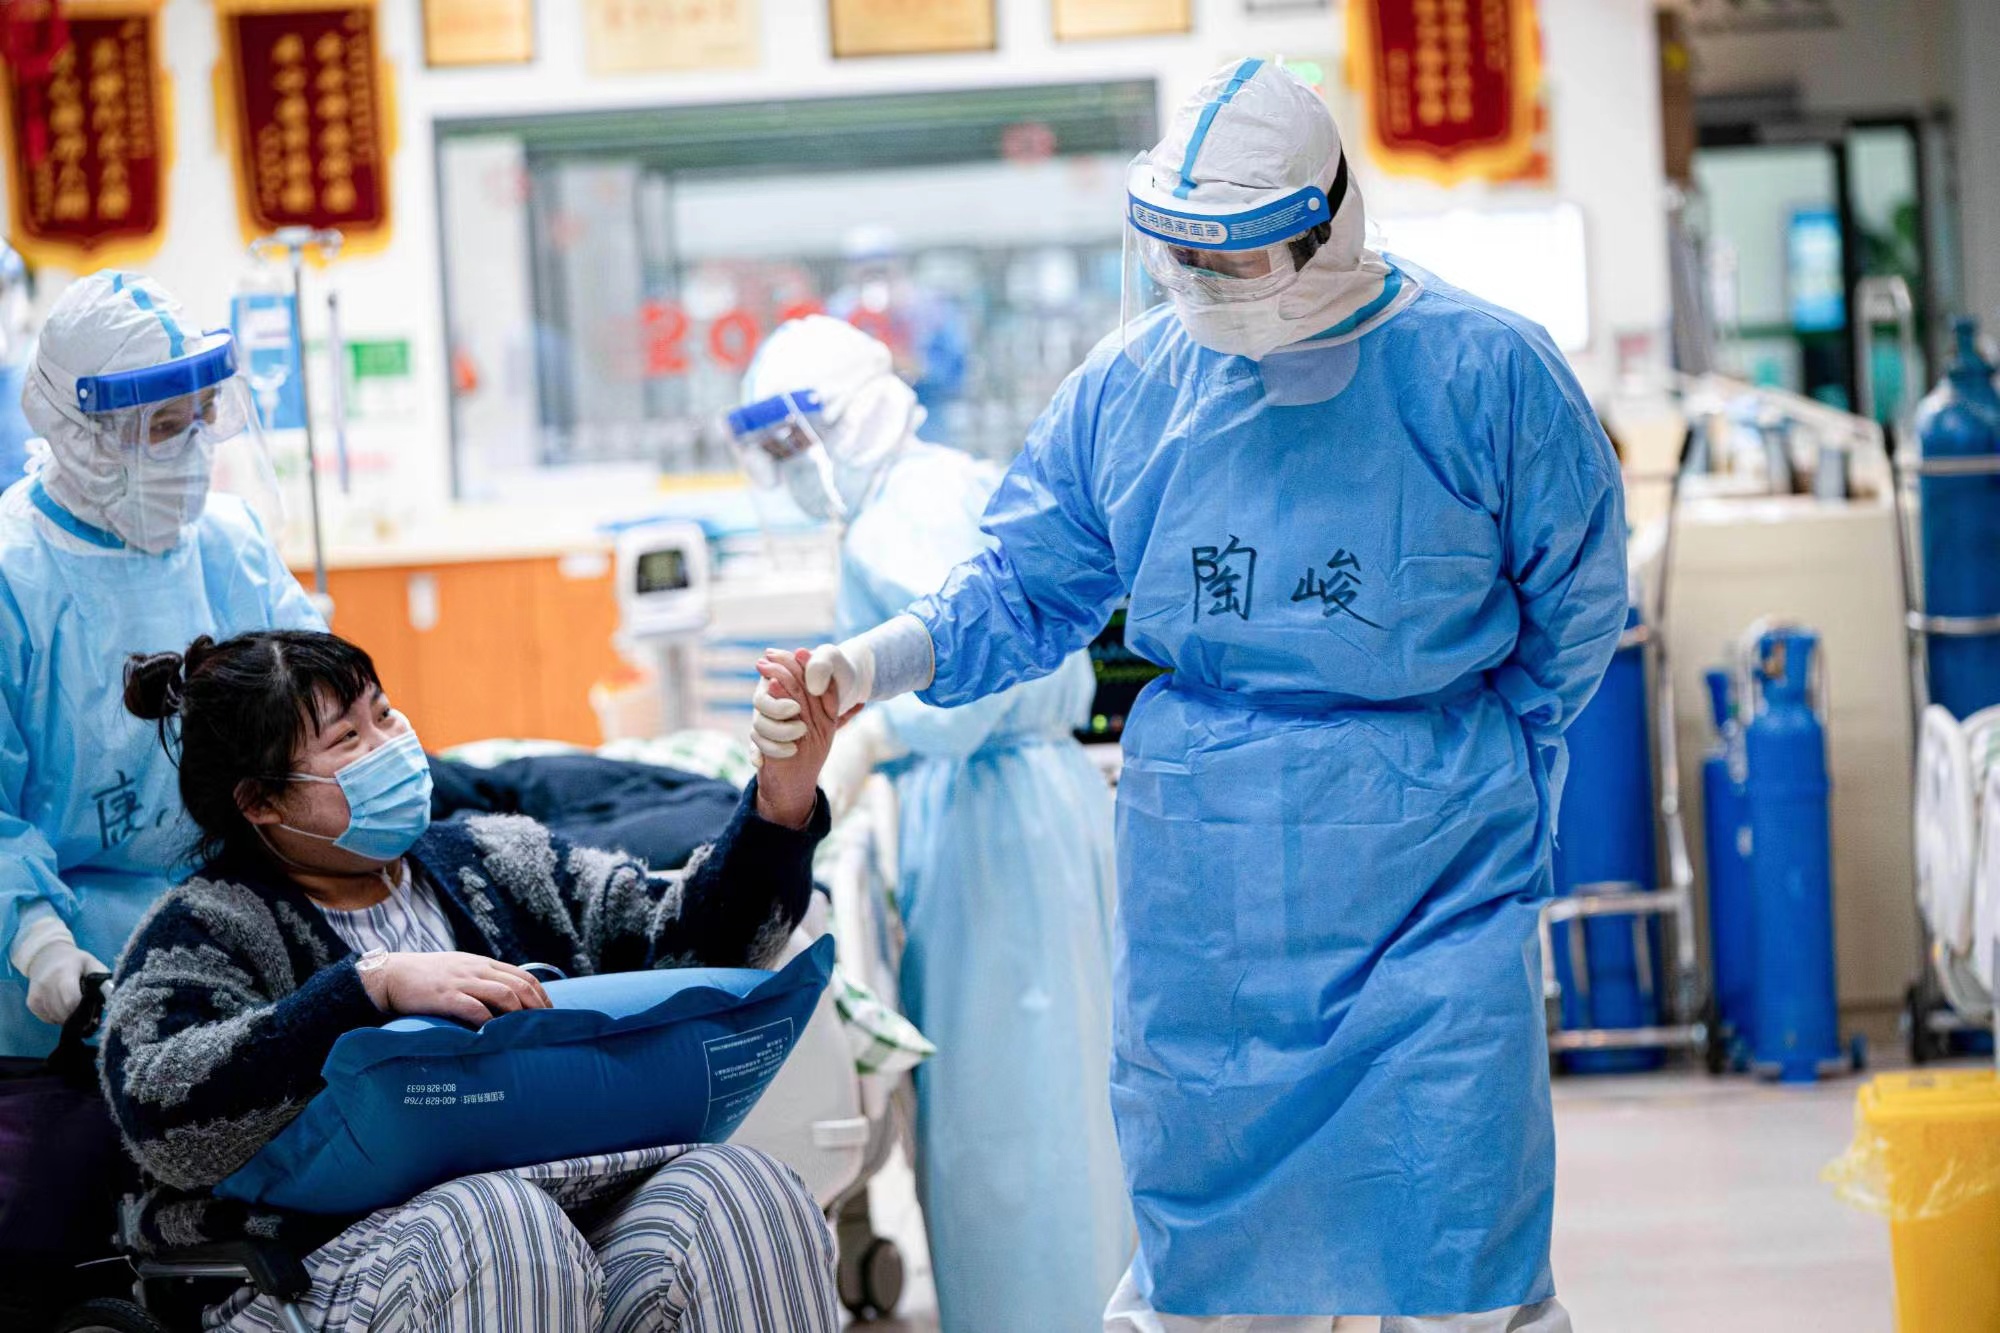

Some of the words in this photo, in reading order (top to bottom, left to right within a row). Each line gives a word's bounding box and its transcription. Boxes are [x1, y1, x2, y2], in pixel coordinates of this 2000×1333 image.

[1135, 205, 1221, 238] 医用隔离面罩
[406, 1084, 426, 1093] 6633
[427, 1083, 457, 1093] 800-828
[425, 1096, 456, 1105] 400-828
